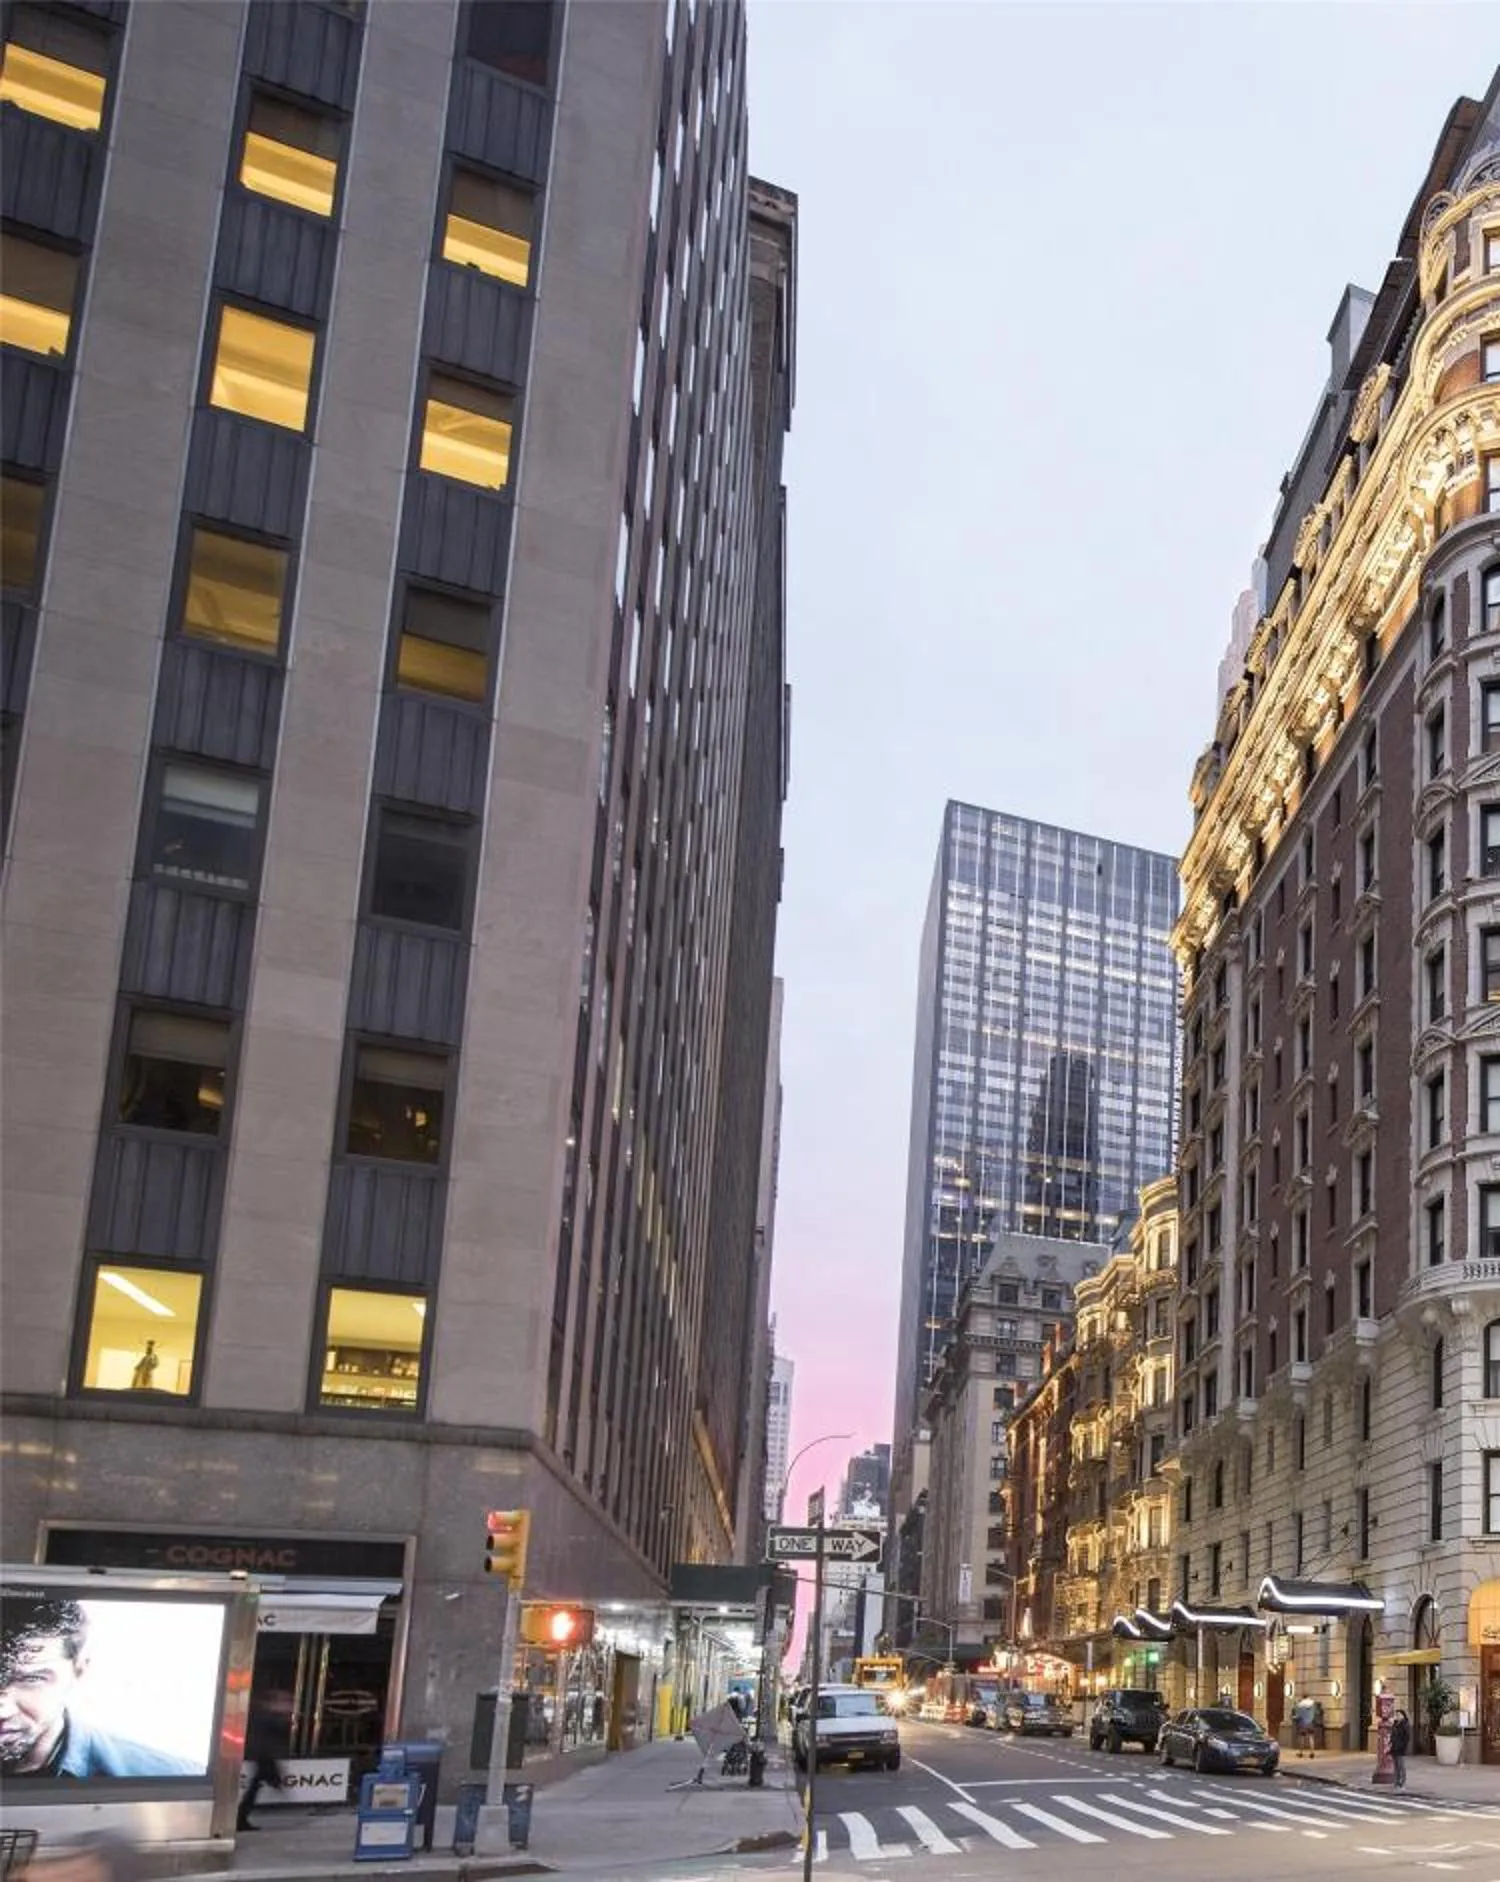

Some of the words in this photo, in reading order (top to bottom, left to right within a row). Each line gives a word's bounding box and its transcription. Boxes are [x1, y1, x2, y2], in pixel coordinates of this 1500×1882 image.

[780, 1537, 812, 1551] ONE
[831, 1539, 865, 1552] WAY
[166, 1545, 297, 1567] COGNAC
[273, 1774, 345, 1789] GNAC
